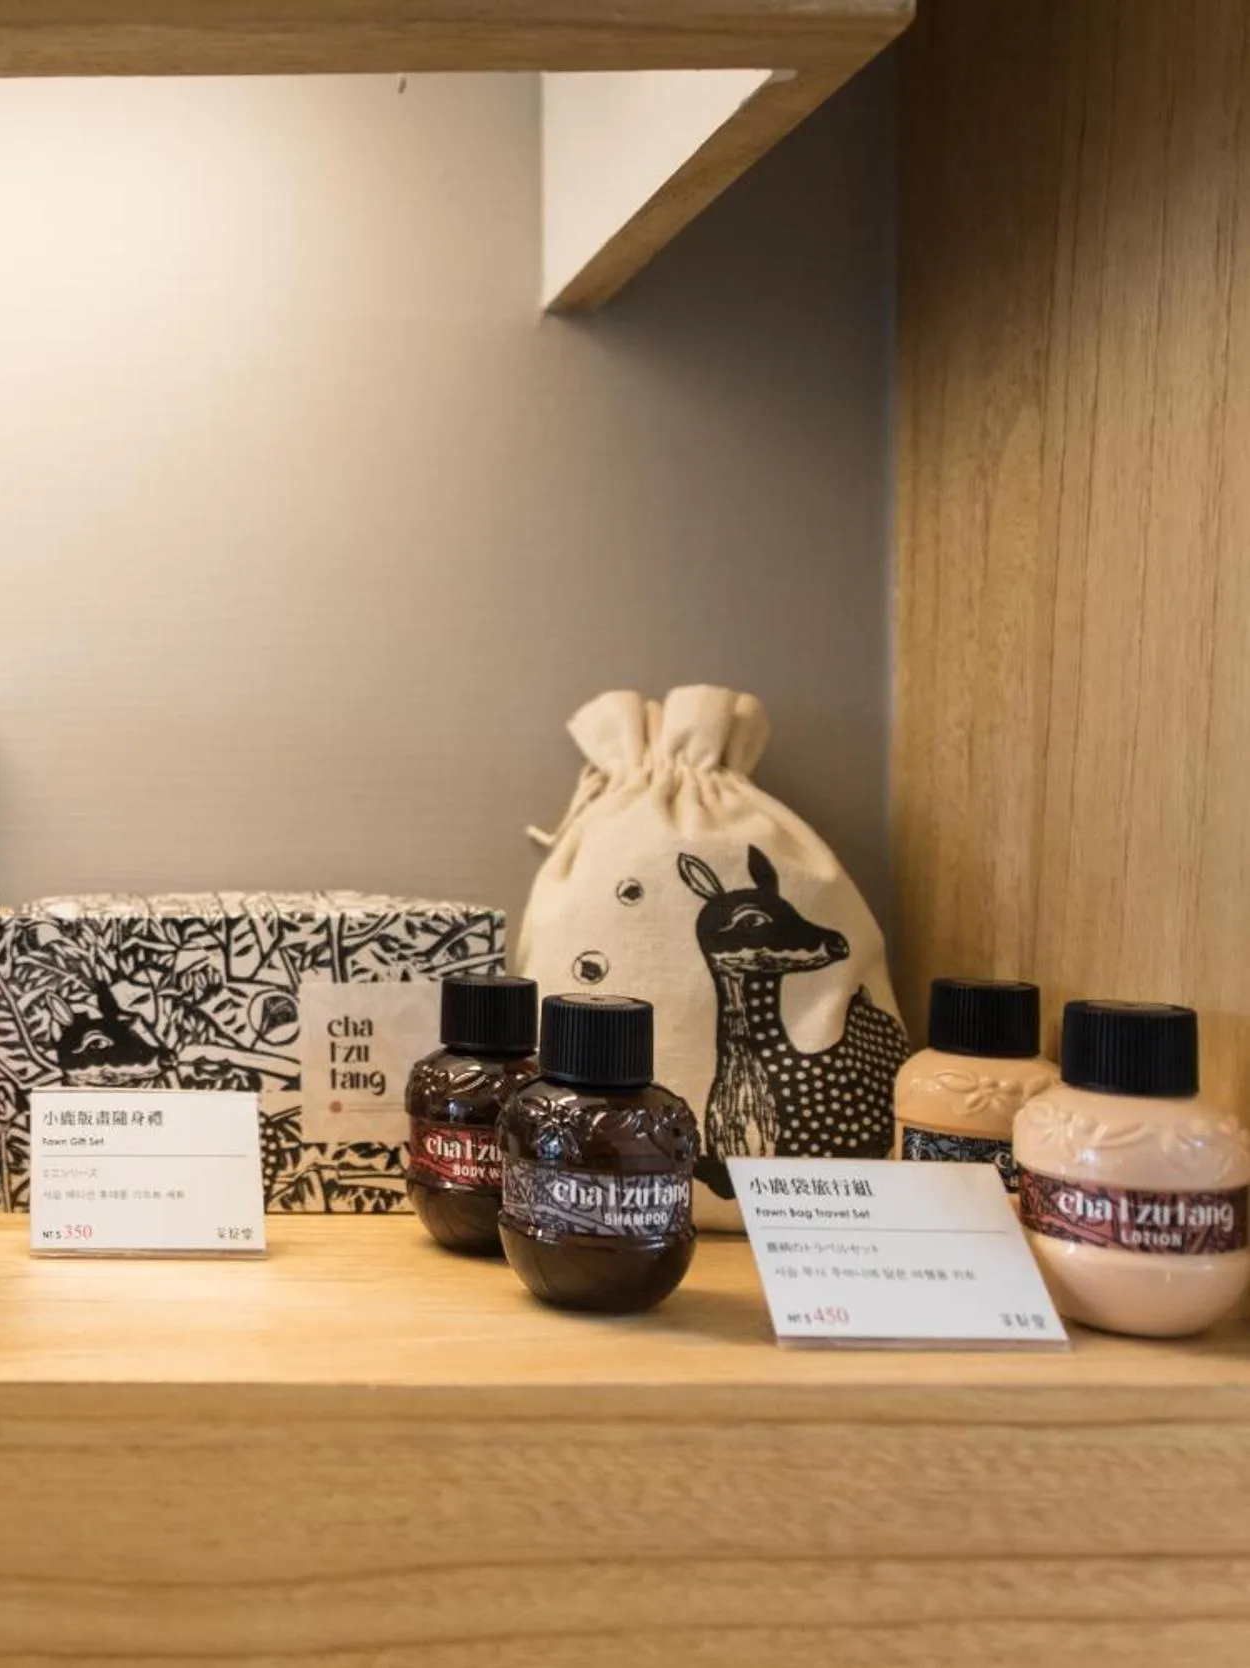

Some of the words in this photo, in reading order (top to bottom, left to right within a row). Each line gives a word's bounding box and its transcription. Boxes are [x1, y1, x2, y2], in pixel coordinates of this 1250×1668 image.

[327, 1016, 374, 1038] cha
[330, 1041, 370, 1063] tzu
[331, 1068, 386, 1096] tang
[42, 1137, 67, 1146] Fawn
[70, 1137, 87, 1146] Gift
[89, 1137, 104, 1146] Set
[426, 1135, 462, 1159] cha
[453, 1163, 486, 1178] BODY
[553, 1180, 602, 1207] cha
[609, 1183, 649, 1207] tzu
[653, 1181, 689, 1208] tang
[750, 1177, 876, 1198] 小鹿袋旅行組
[604, 1212, 667, 1226] SHAMPOO
[755, 1207, 787, 1218] Fawn
[789, 1208, 813, 1220] Bag
[815, 1208, 850, 1219] Travel
[851, 1208, 870, 1219] Set
[1057, 1191, 1112, 1220] cha
[1119, 1197, 1170, 1226] tzu
[1177, 1201, 1234, 1232] tang
[63, 1224, 93, 1240] 350
[1120, 1230, 1182, 1247] LOTION
[813, 1307, 850, 1325] 450
